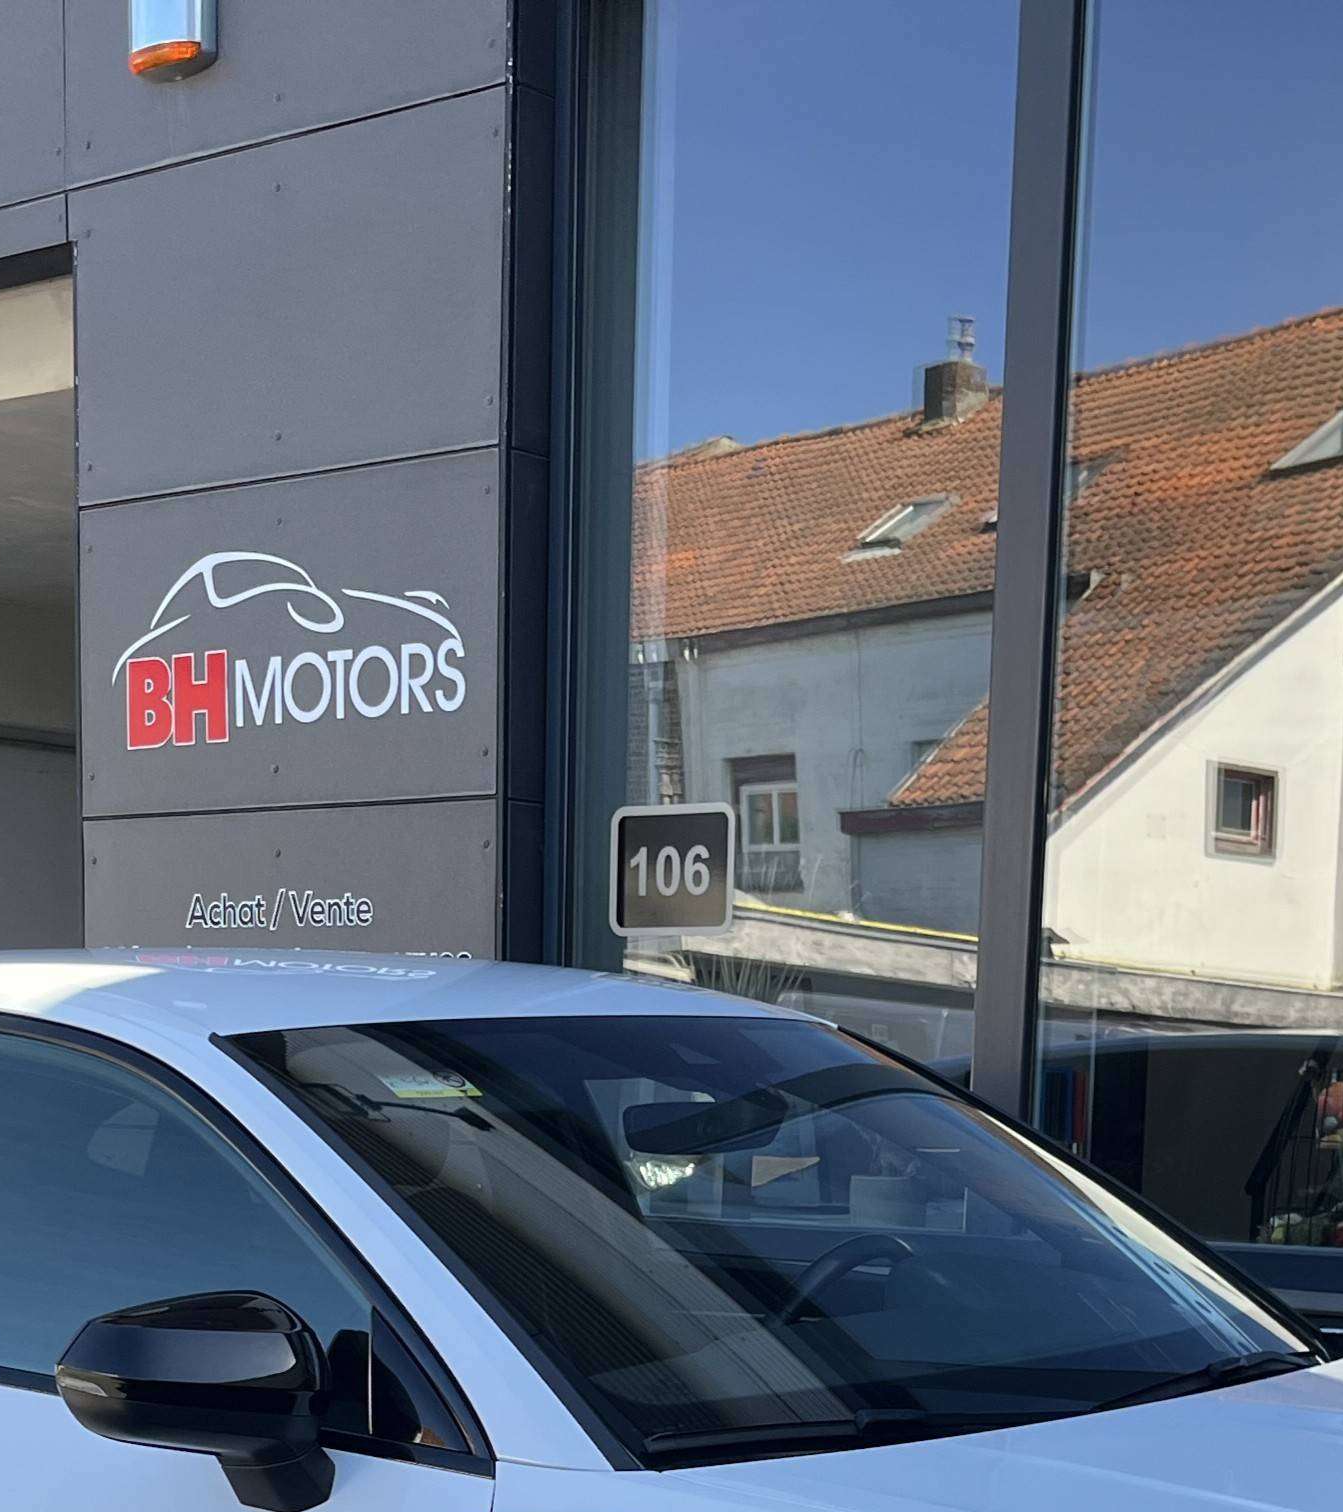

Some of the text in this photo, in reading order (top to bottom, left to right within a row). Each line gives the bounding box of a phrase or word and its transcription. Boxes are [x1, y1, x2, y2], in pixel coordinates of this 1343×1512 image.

[234, 637, 467, 728] MOTORS
[629, 844, 711, 897] 106
[185, 888, 374, 931] Achat / Vente
